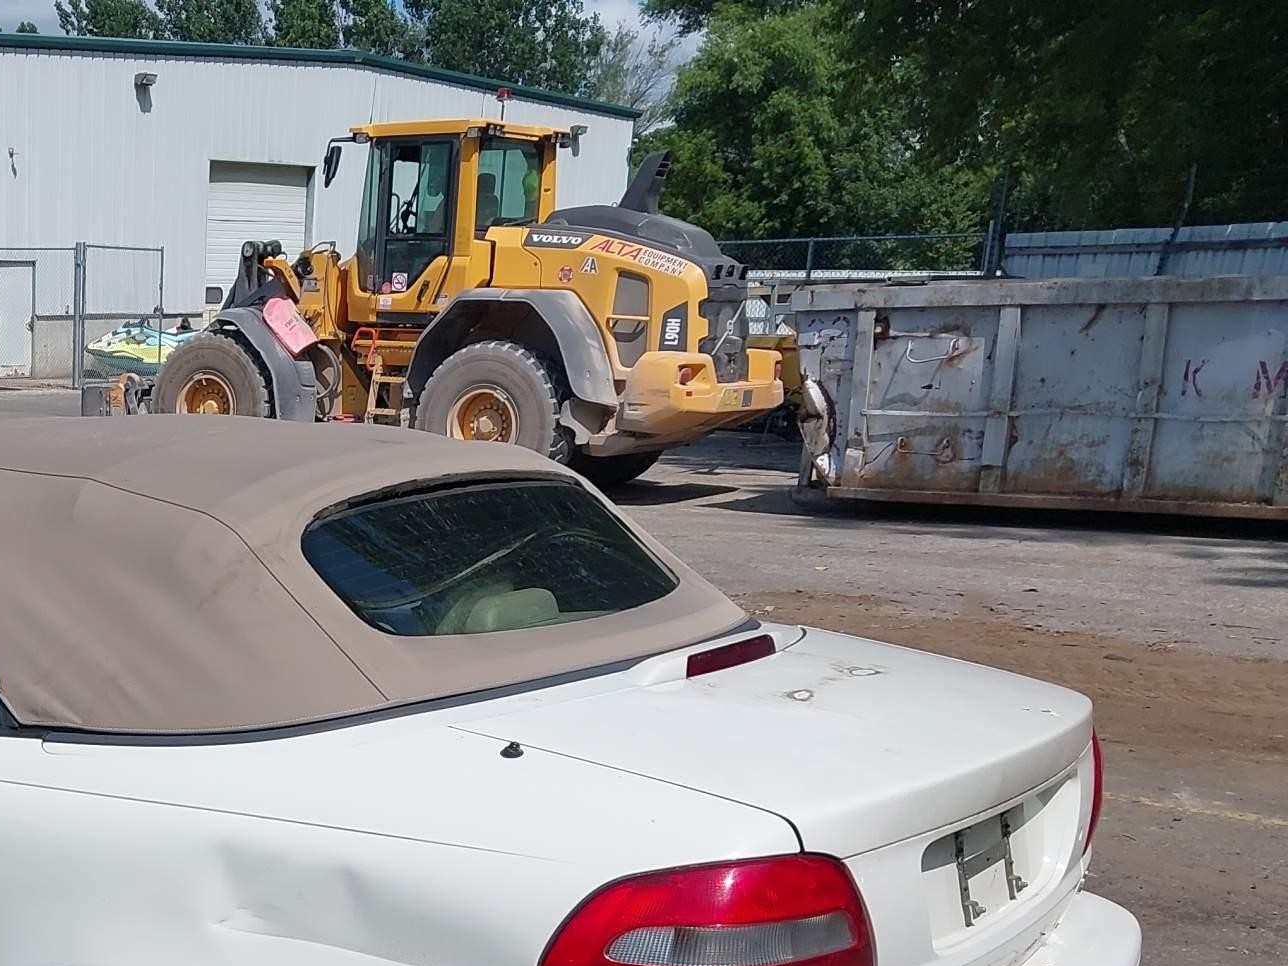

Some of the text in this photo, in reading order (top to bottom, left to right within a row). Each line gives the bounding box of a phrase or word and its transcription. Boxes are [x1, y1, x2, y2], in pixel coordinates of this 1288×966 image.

[532, 234, 582, 245] VOLVO
[590, 239, 688, 269] ALTA EQUIPMENT
[638, 256, 684, 277] COMPANY
[663, 318, 681, 346] L90H
